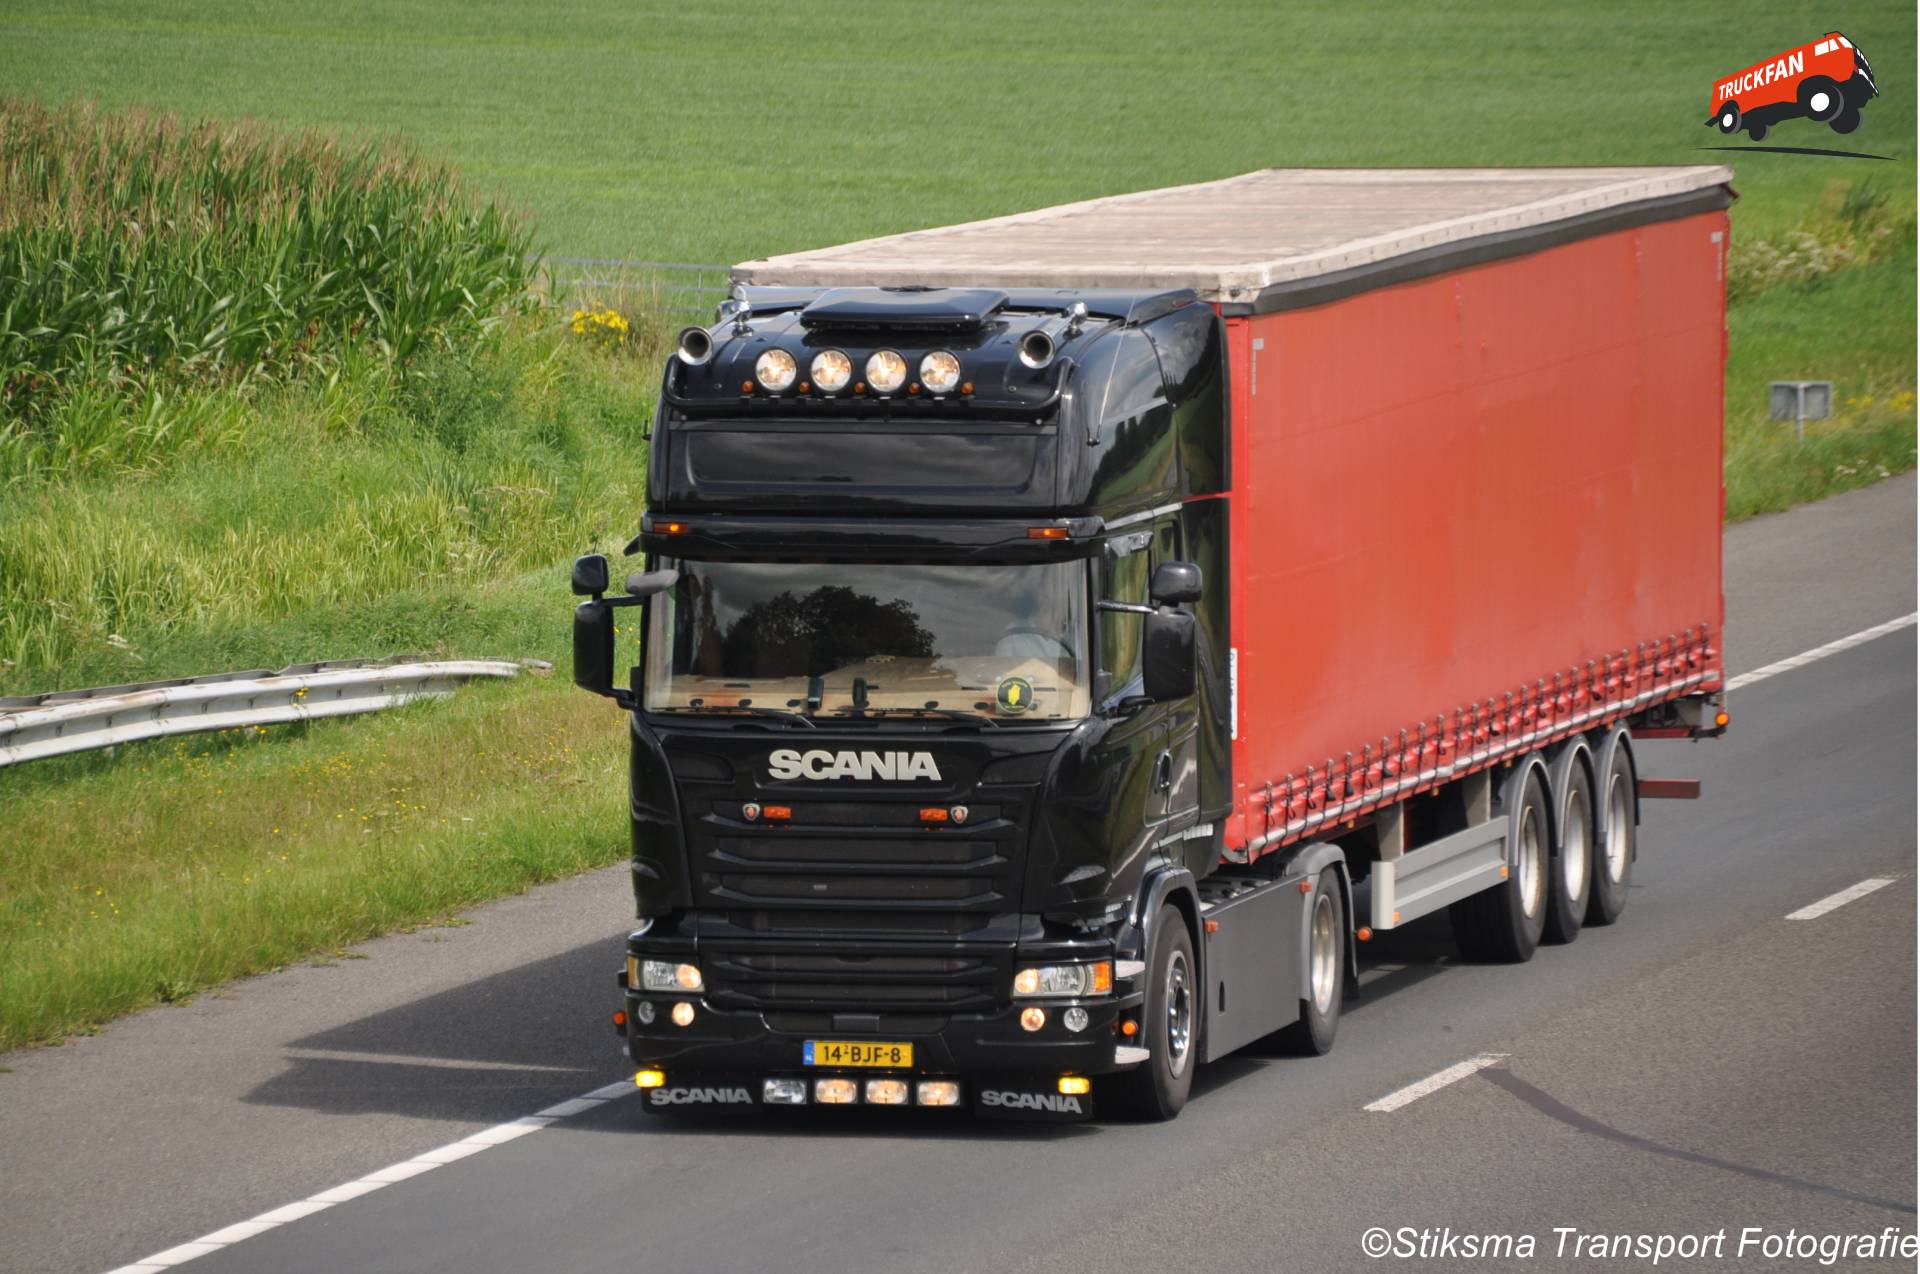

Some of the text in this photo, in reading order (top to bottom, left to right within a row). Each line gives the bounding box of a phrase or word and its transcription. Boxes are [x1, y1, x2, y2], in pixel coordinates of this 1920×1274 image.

[768, 749, 942, 781] SCANIA
[650, 1087, 753, 1106] SCANIA
[981, 1090, 1082, 1114] SCANIA
